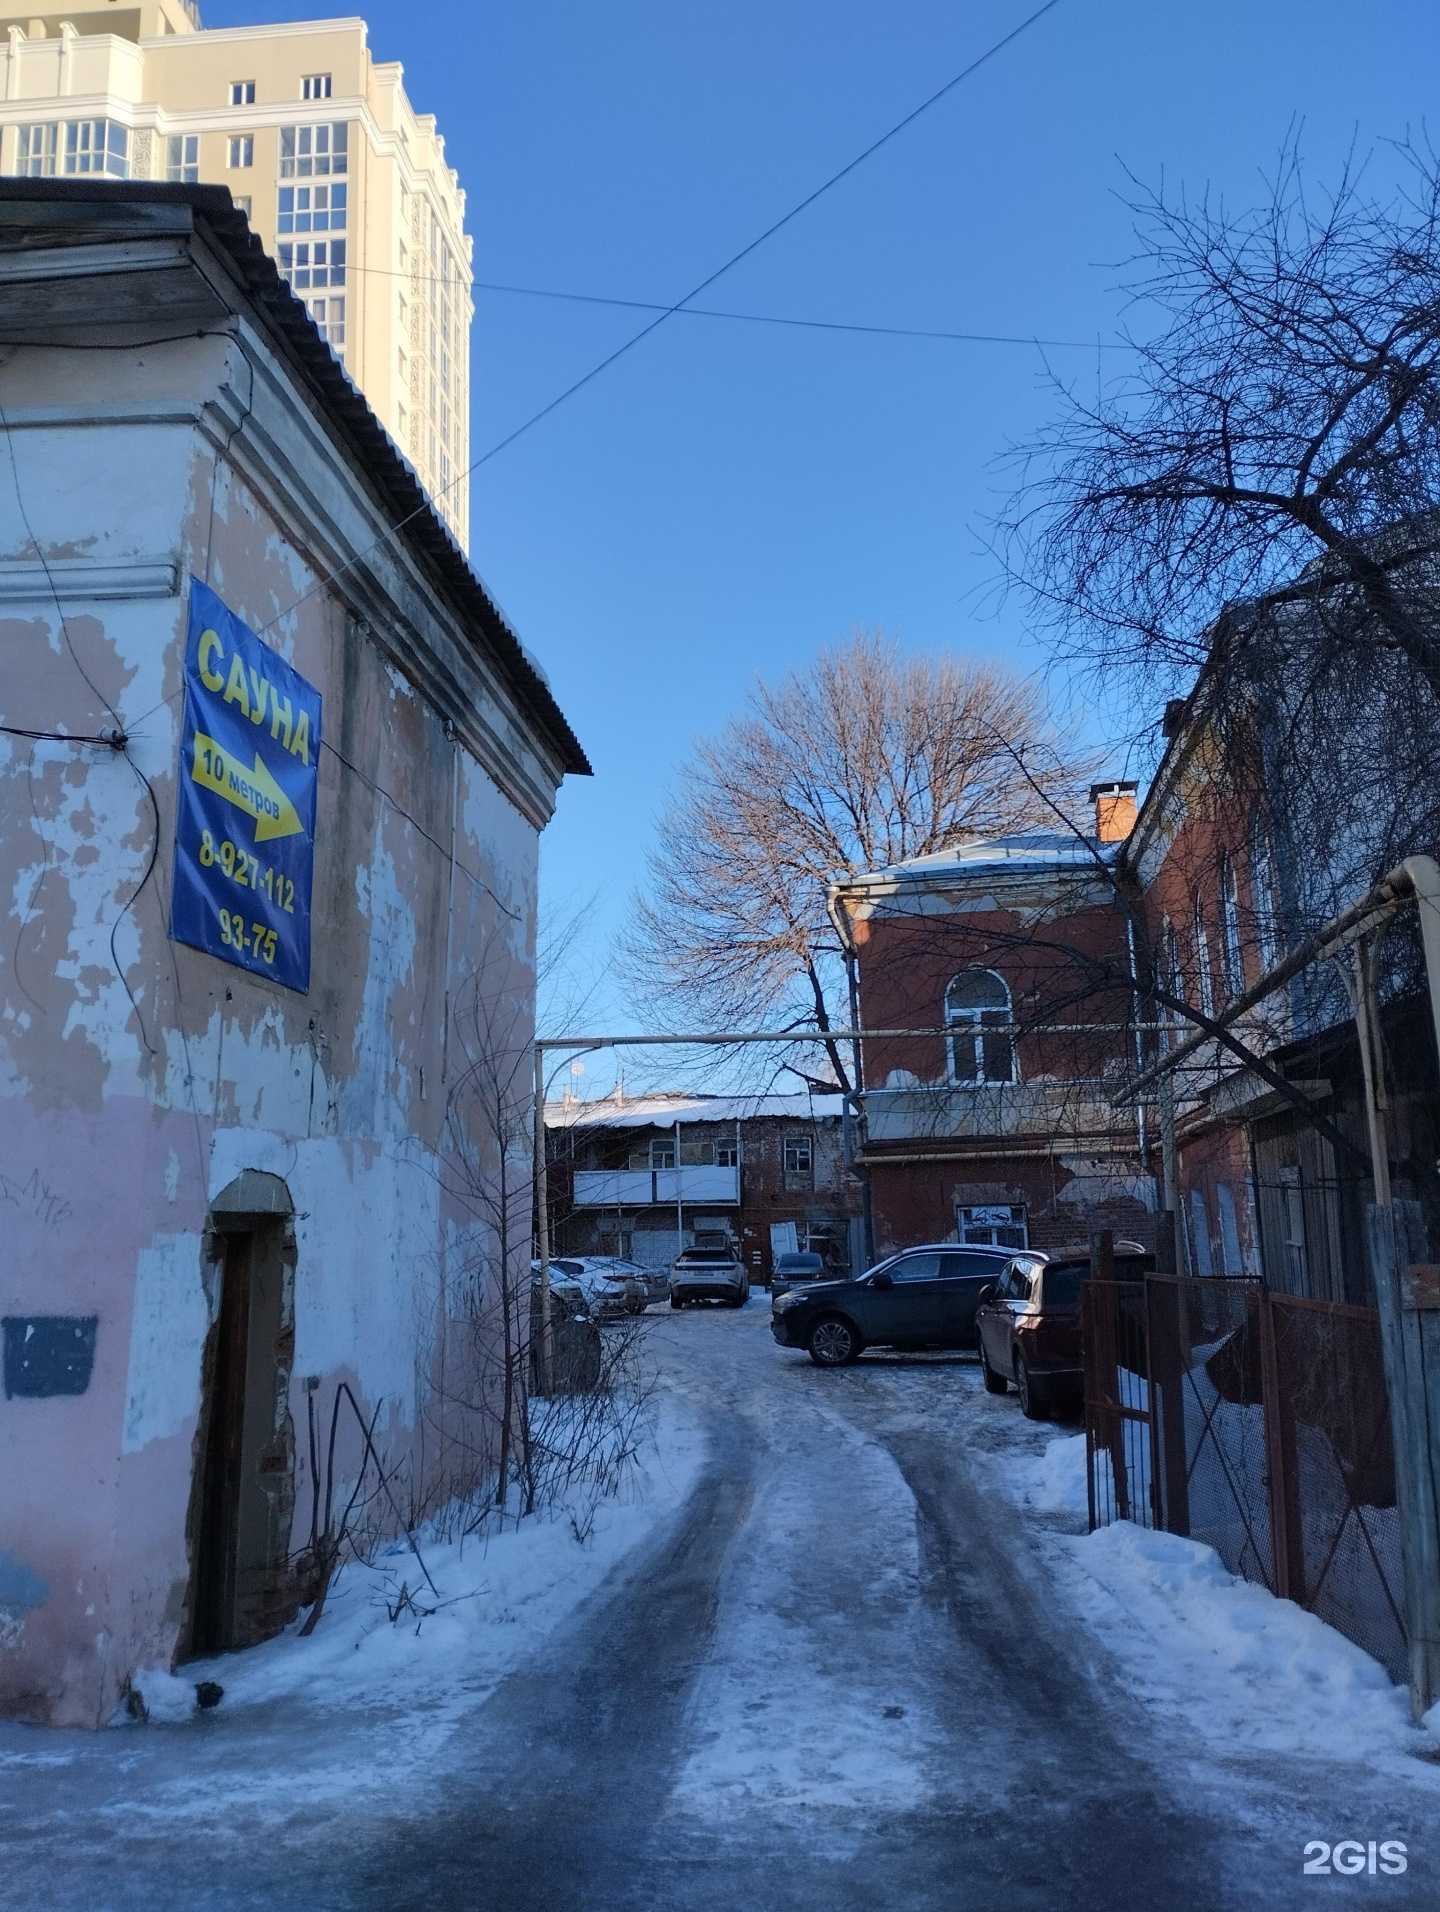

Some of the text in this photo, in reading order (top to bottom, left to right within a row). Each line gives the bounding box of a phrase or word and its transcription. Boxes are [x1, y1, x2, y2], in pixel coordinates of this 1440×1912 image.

[198, 628, 311, 767] САУНА
[203, 748, 280, 820] 10 метров
[199, 829, 295, 914] 8-927-112
[219, 908, 279, 964] 93-75
